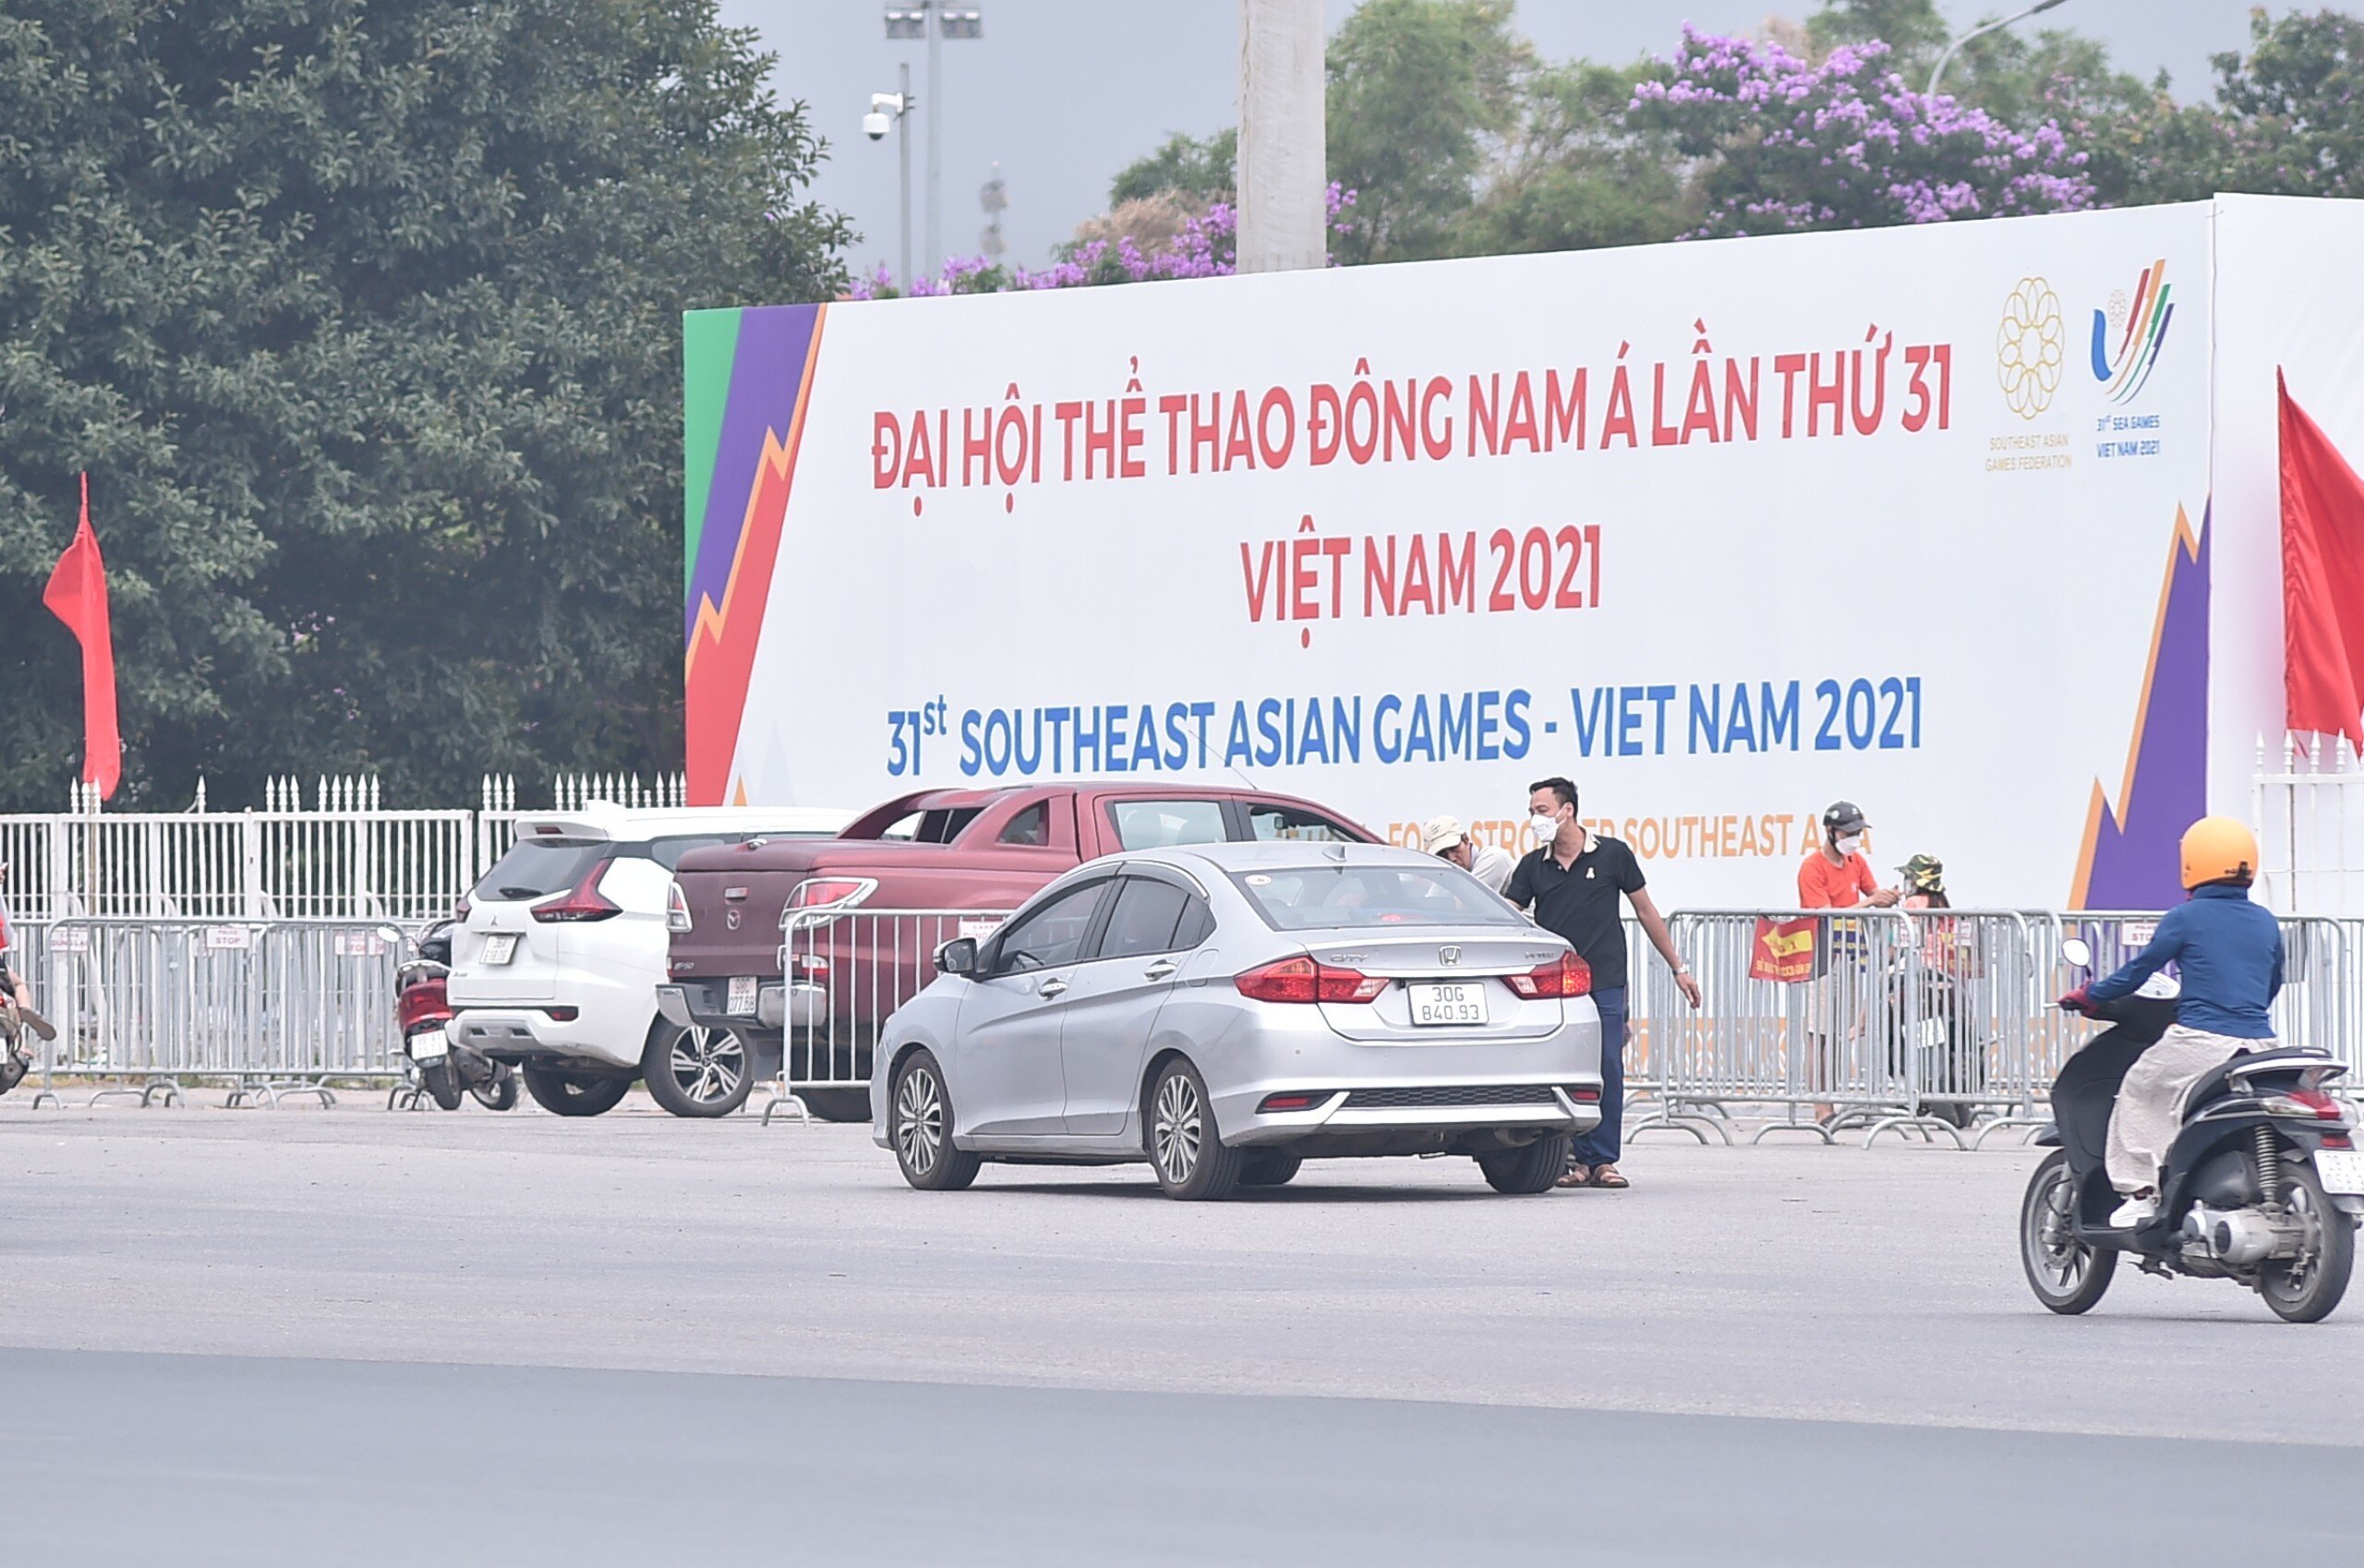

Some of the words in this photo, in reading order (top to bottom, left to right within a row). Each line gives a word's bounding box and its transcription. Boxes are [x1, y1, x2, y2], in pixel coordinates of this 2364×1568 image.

[872, 409, 948, 516] ĐẠI
[962, 382, 1042, 513] HỘI
[1055, 356, 1147, 482] THỂ
[1159, 385, 1296, 476] THAO
[1307, 356, 1453, 467] ĐÔNG
[1467, 367, 1588, 458] NAM
[1600, 340, 1638, 450] Á
[1651, 318, 1760, 447] LẦN
[1774, 323, 1894, 440] THỨ
[1901, 344, 1952, 433] 31
[2113, 416, 2129, 430] SEA
[2130, 415, 2160, 428] GAMES
[1989, 435, 2040, 451] SOUTHEAST
[2044, 433, 2069, 448] ASIAN
[2096, 442, 2116, 458] VIET
[2117, 441, 2139, 457] NAM
[2140, 440, 2160, 455] 2021
[1984, 457, 2016, 472] GAMES
[2019, 454, 2073, 470] FEDERATION
[1240, 514, 1353, 649] VIỆT
[1364, 531, 1477, 617] NAM
[1489, 524, 1601, 613] 2021
[886, 694, 948, 778] 31st
[959, 701, 1216, 778] SOUTHEAST
[1224, 694, 1362, 768] ASIAN
[1372, 688, 1533, 766] GAMES
[1570, 684, 1677, 759] VIET
[1688, 680, 1801, 755] NAM
[1814, 676, 1923, 753] 2021
[1389, 822, 1428, 851] FO
[1623, 814, 1794, 860] SOUTHEAST
[1801, 814, 1872, 855] AA
[215, 936, 240, 945] STOP
[2131, 933, 2153, 941] STO
[1331, 954, 1369, 962] CITY
[1431, 986, 1465, 1003] 30G
[1422, 1004, 1479, 1020] 840.93
